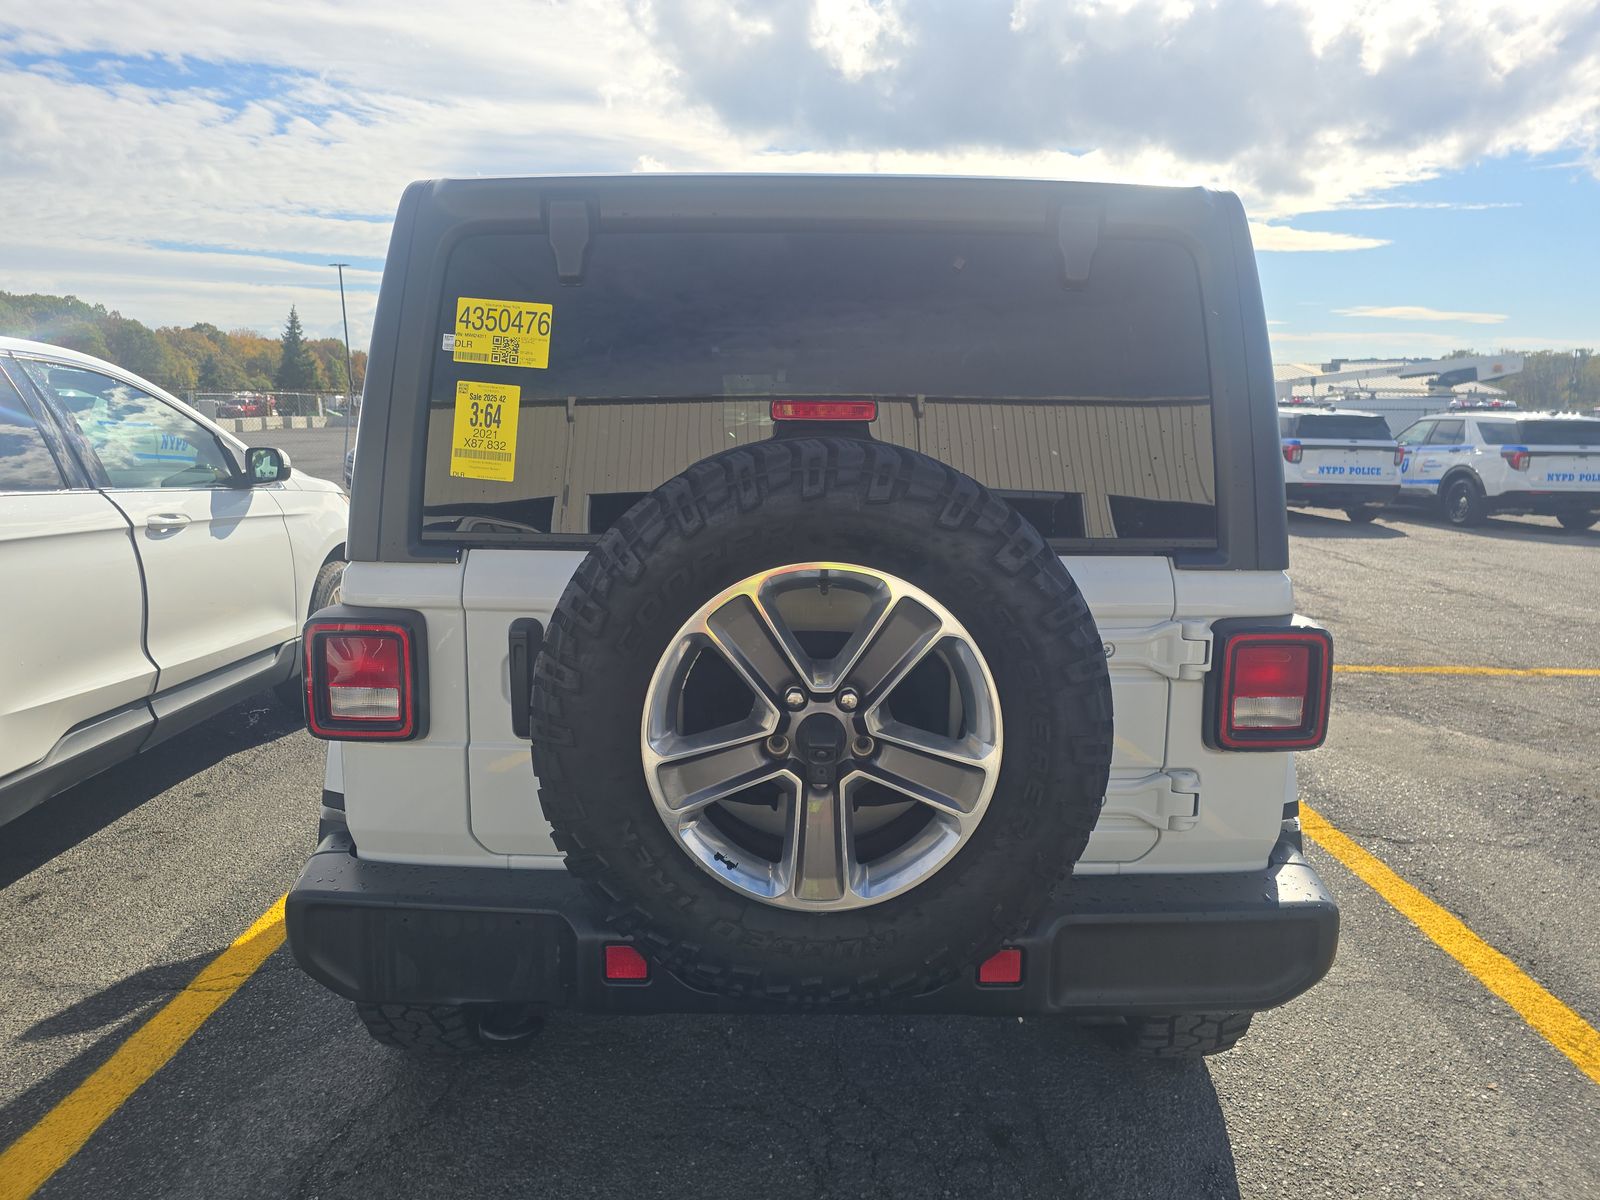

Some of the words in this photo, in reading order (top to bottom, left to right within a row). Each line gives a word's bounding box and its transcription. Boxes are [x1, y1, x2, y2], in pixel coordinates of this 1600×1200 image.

[458, 306, 551, 337] 4350476
[454, 339, 473, 348] DLR
[469, 393, 482, 401] Sale
[483, 394, 497, 402] 2025
[499, 395, 507, 403] 42
[473, 429, 497, 439] 2021
[161, 434, 188, 451] NYPD
[1318, 465, 1345, 474] NYPD
[1348, 465, 1381, 475] POLICE
[1547, 473, 1574, 482] NYPD
